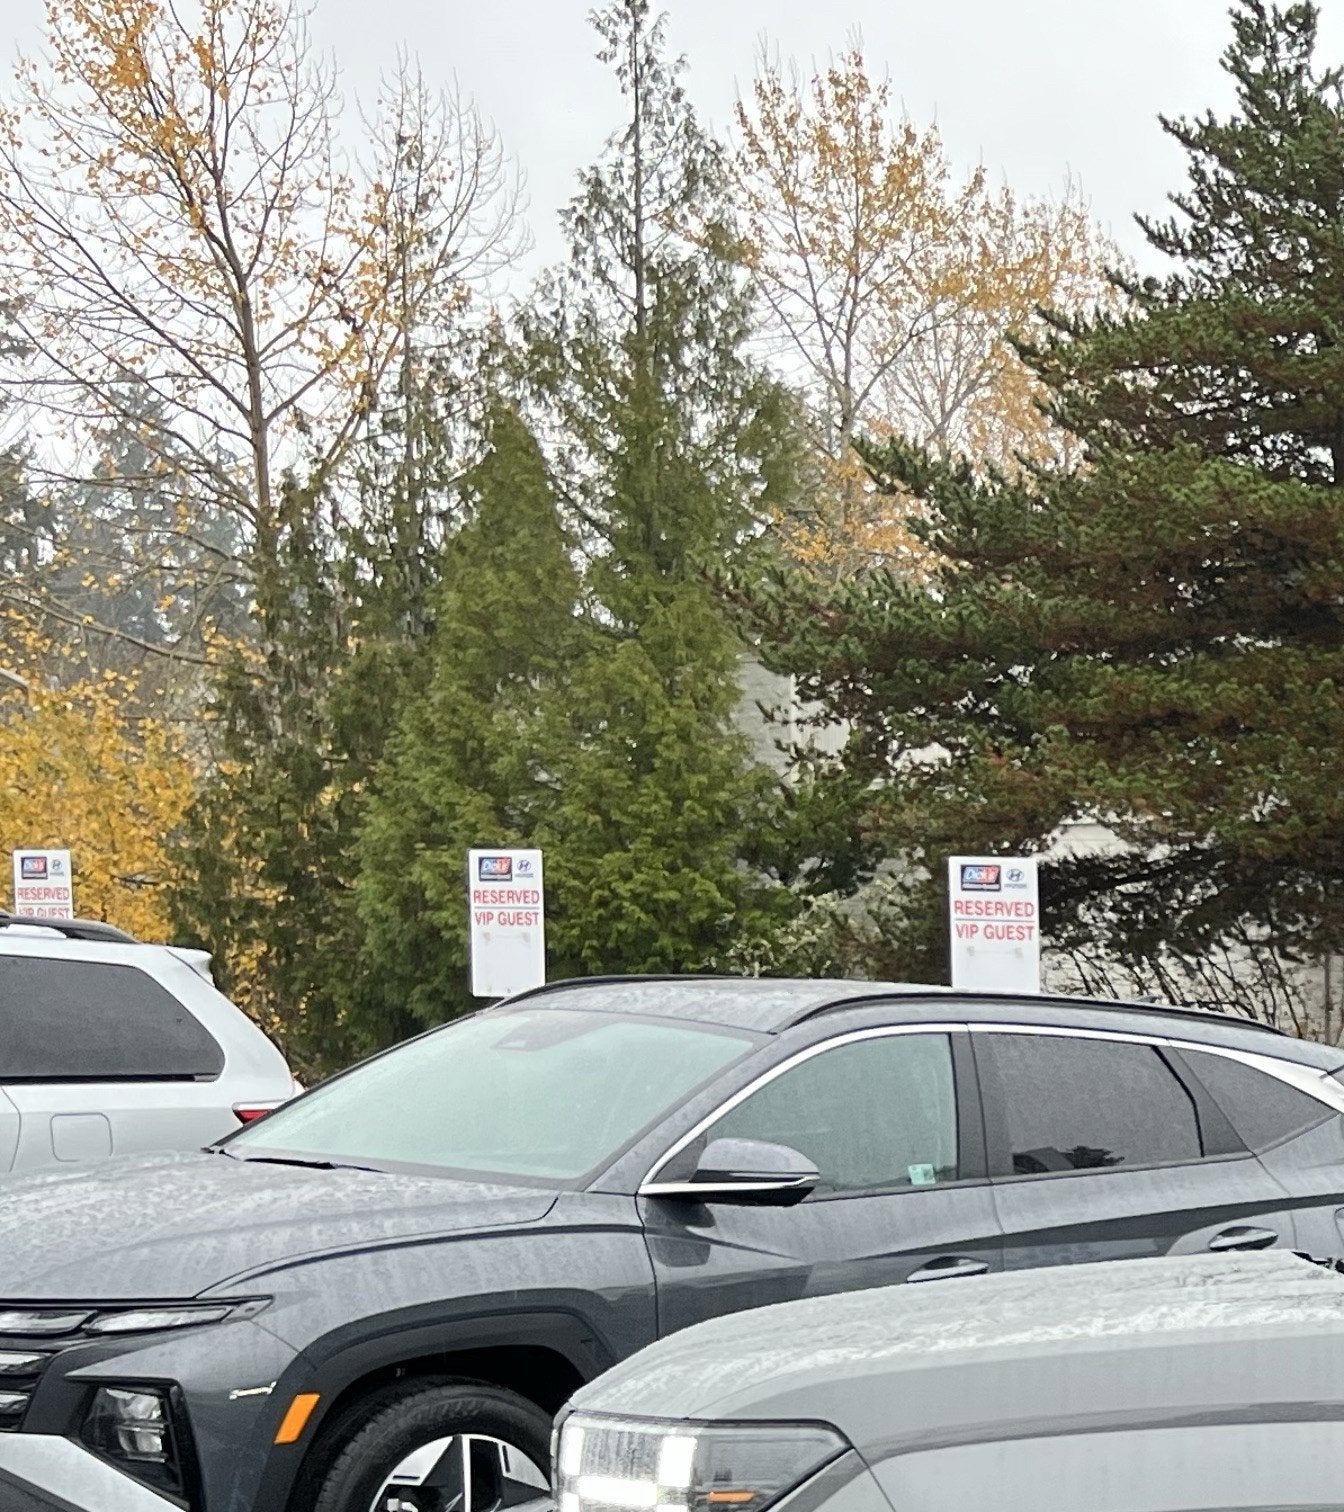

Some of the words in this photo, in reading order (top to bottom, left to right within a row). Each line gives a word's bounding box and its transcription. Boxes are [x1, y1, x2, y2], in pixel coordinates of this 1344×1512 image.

[17, 887, 70, 900] RESERVED
[473, 890, 540, 904] RESERVED
[954, 900, 1035, 917] RESERVED
[474, 912, 494, 925] VIP
[498, 912, 540, 926] GUEST
[955, 923, 979, 939] VIP
[983, 924, 1035, 941] GUEST
